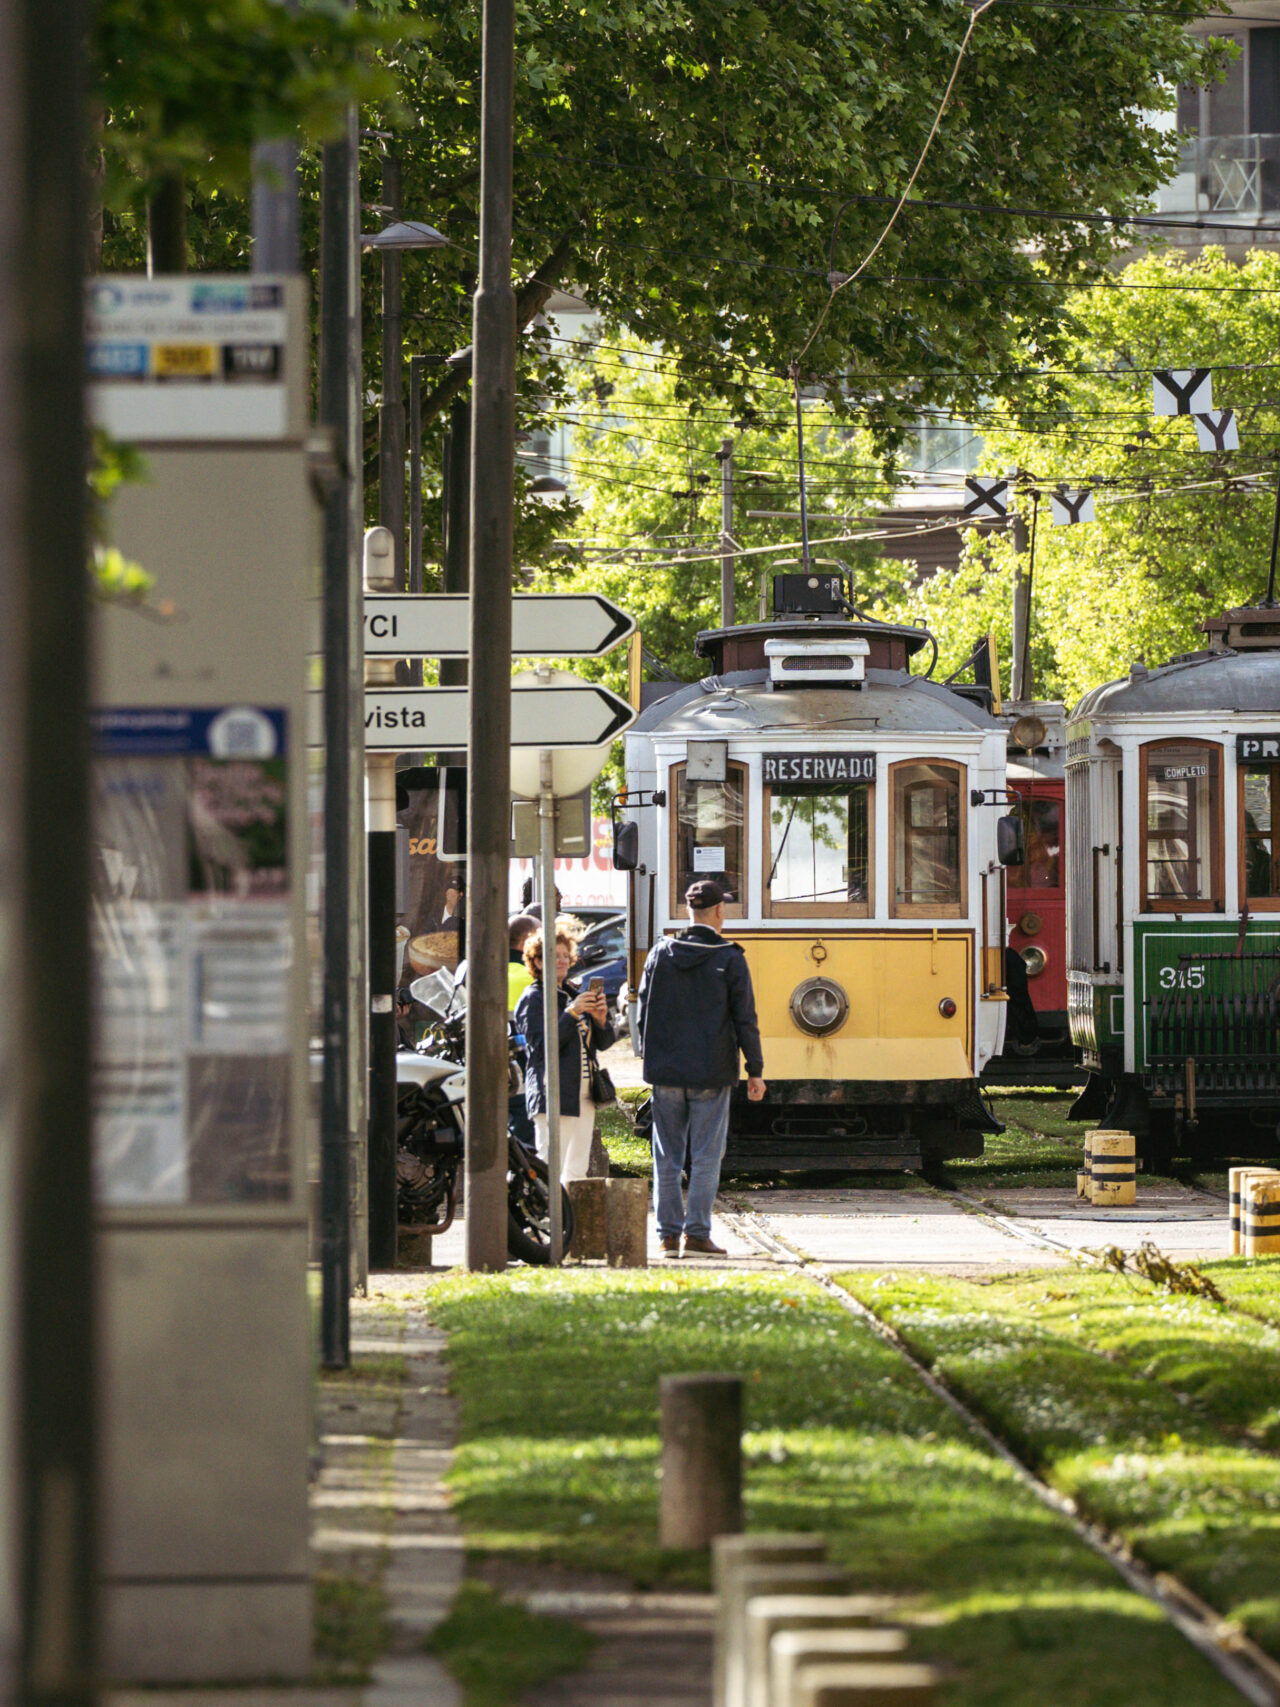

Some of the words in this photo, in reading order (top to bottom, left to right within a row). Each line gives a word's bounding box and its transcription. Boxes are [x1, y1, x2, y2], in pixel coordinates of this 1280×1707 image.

[1153, 369, 1211, 416] Y
[1198, 409, 1234, 450] Y
[964, 478, 1008, 515] X
[1052, 488, 1092, 524] Y
[364, 615, 397, 638] CI
[765, 758, 873, 780] RESERVADO
[1166, 766, 1206, 778] COMPLETO
[1159, 965, 1205, 989] 315
